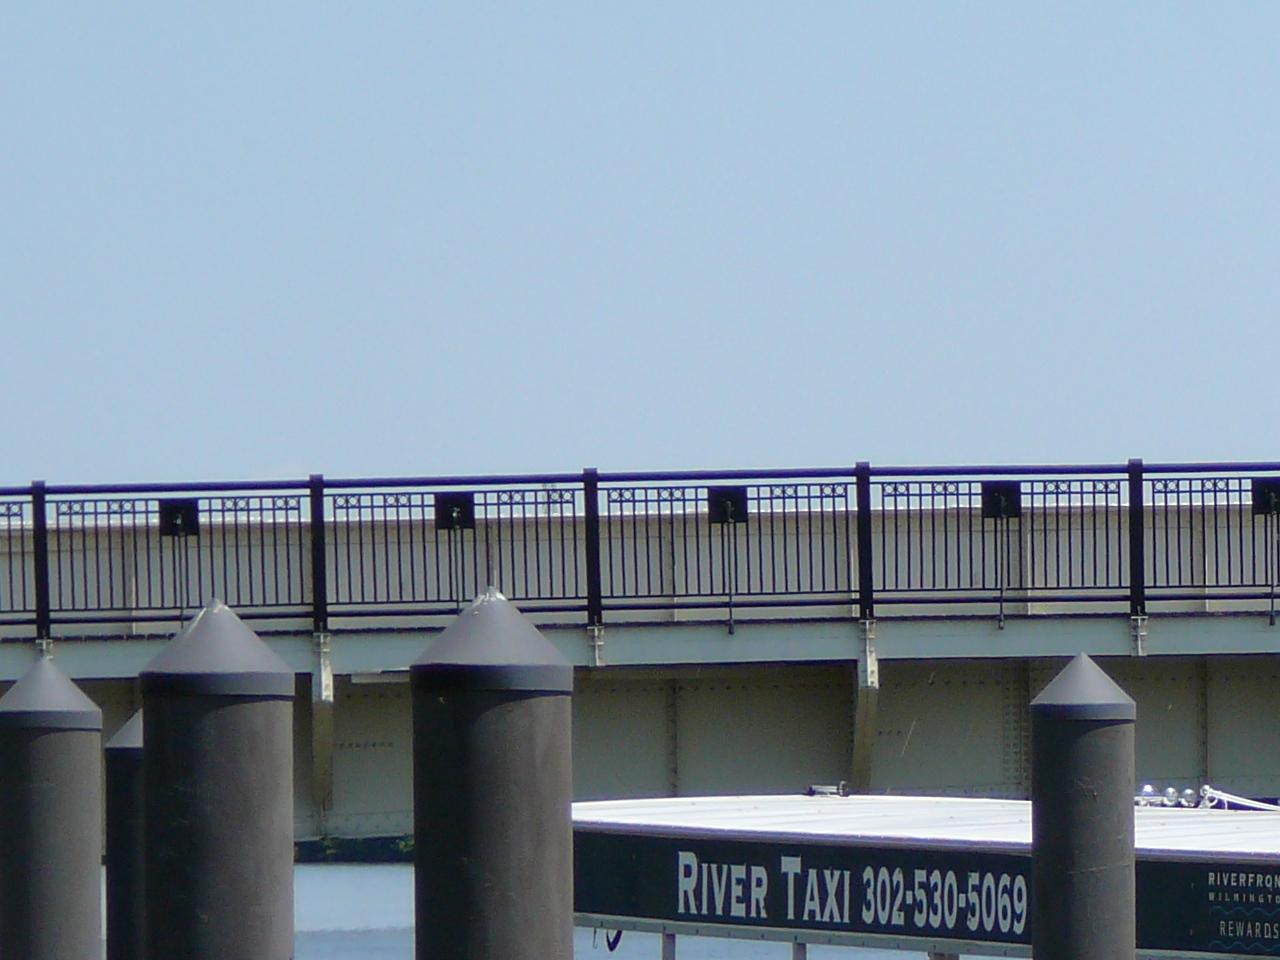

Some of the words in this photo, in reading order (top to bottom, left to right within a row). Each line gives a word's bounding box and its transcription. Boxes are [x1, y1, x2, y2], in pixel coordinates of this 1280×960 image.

[678, 851, 768, 918] RIVER
[781, 855, 850, 923] TAXI
[862, 866, 1027, 935] 302-530-5069
[1220, 921, 1279, 939] REWARDS
